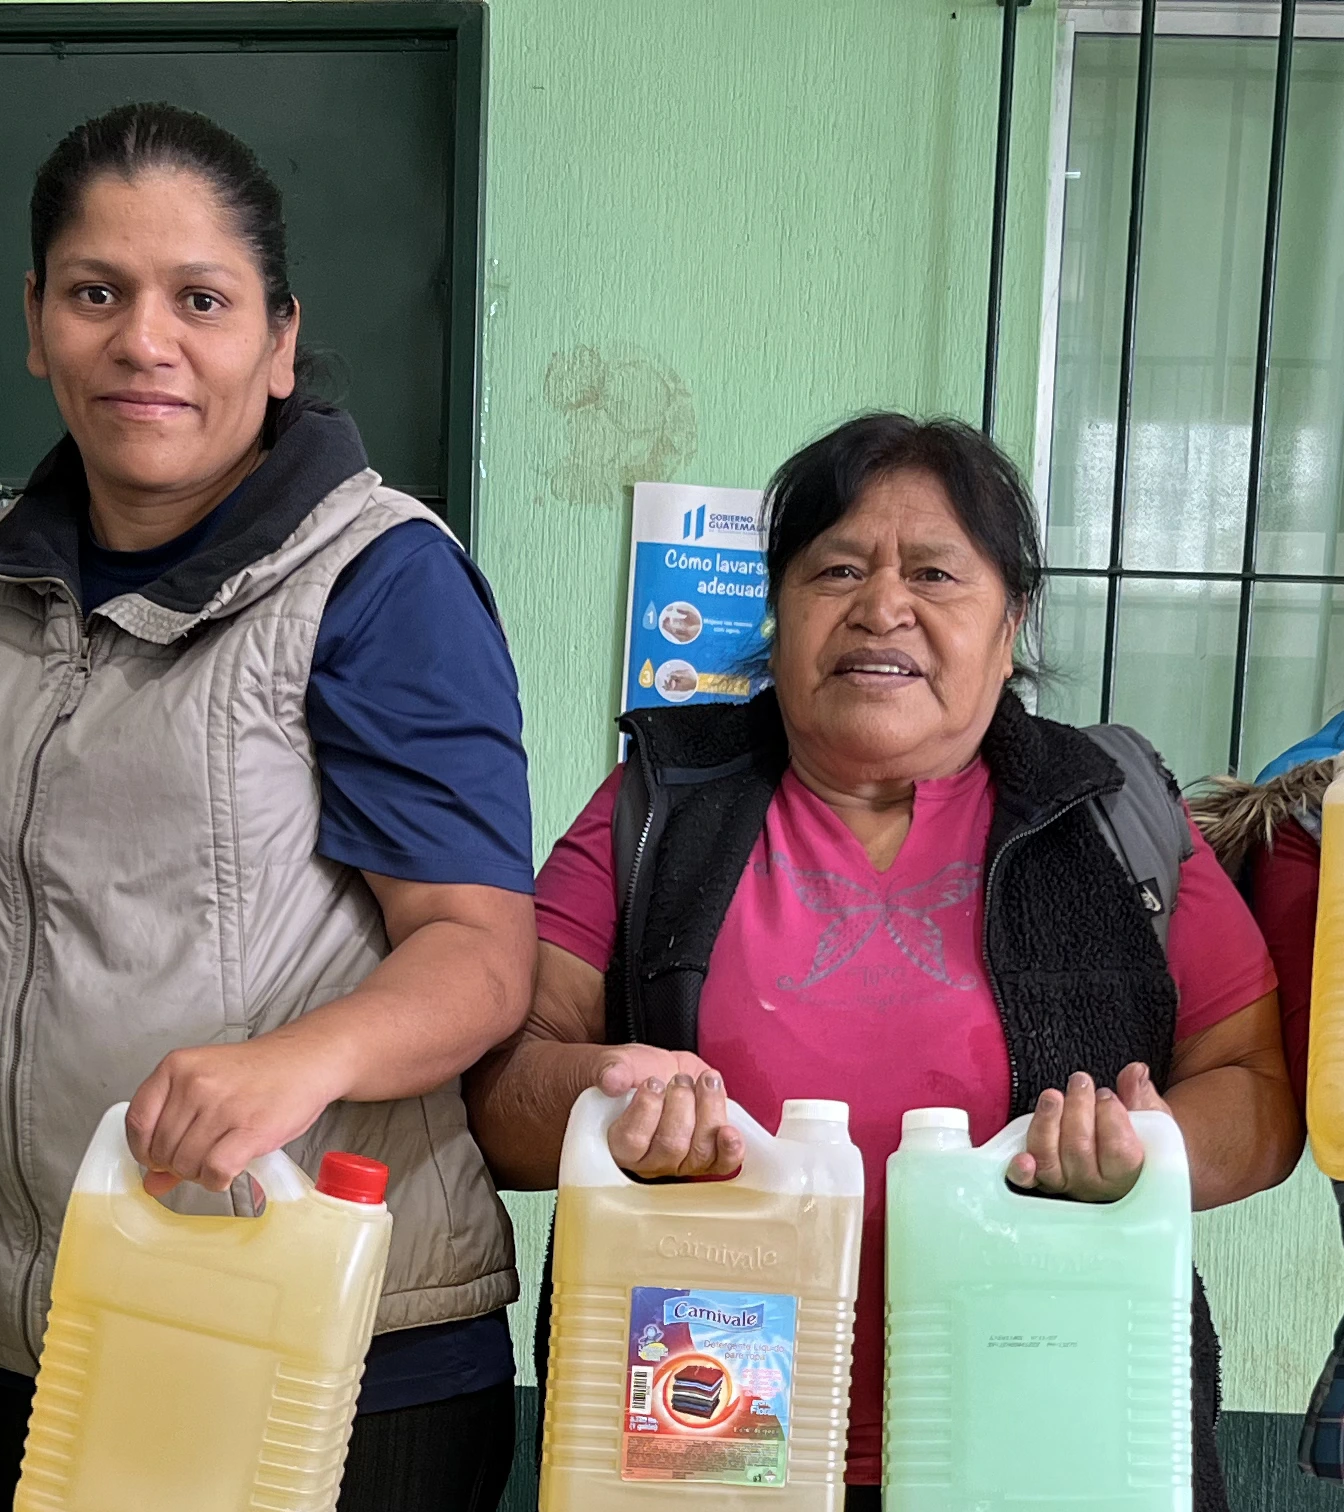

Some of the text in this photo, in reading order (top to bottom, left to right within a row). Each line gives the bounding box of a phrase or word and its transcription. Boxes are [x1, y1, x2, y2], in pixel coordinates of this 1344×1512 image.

[709, 513, 754, 523] GOBIERNO
[664, 548, 769, 576] Cómo lavars
[647, 610, 654, 625] 1
[642, 670, 652, 684] 3
[674, 1302, 758, 1327] Carnivale
